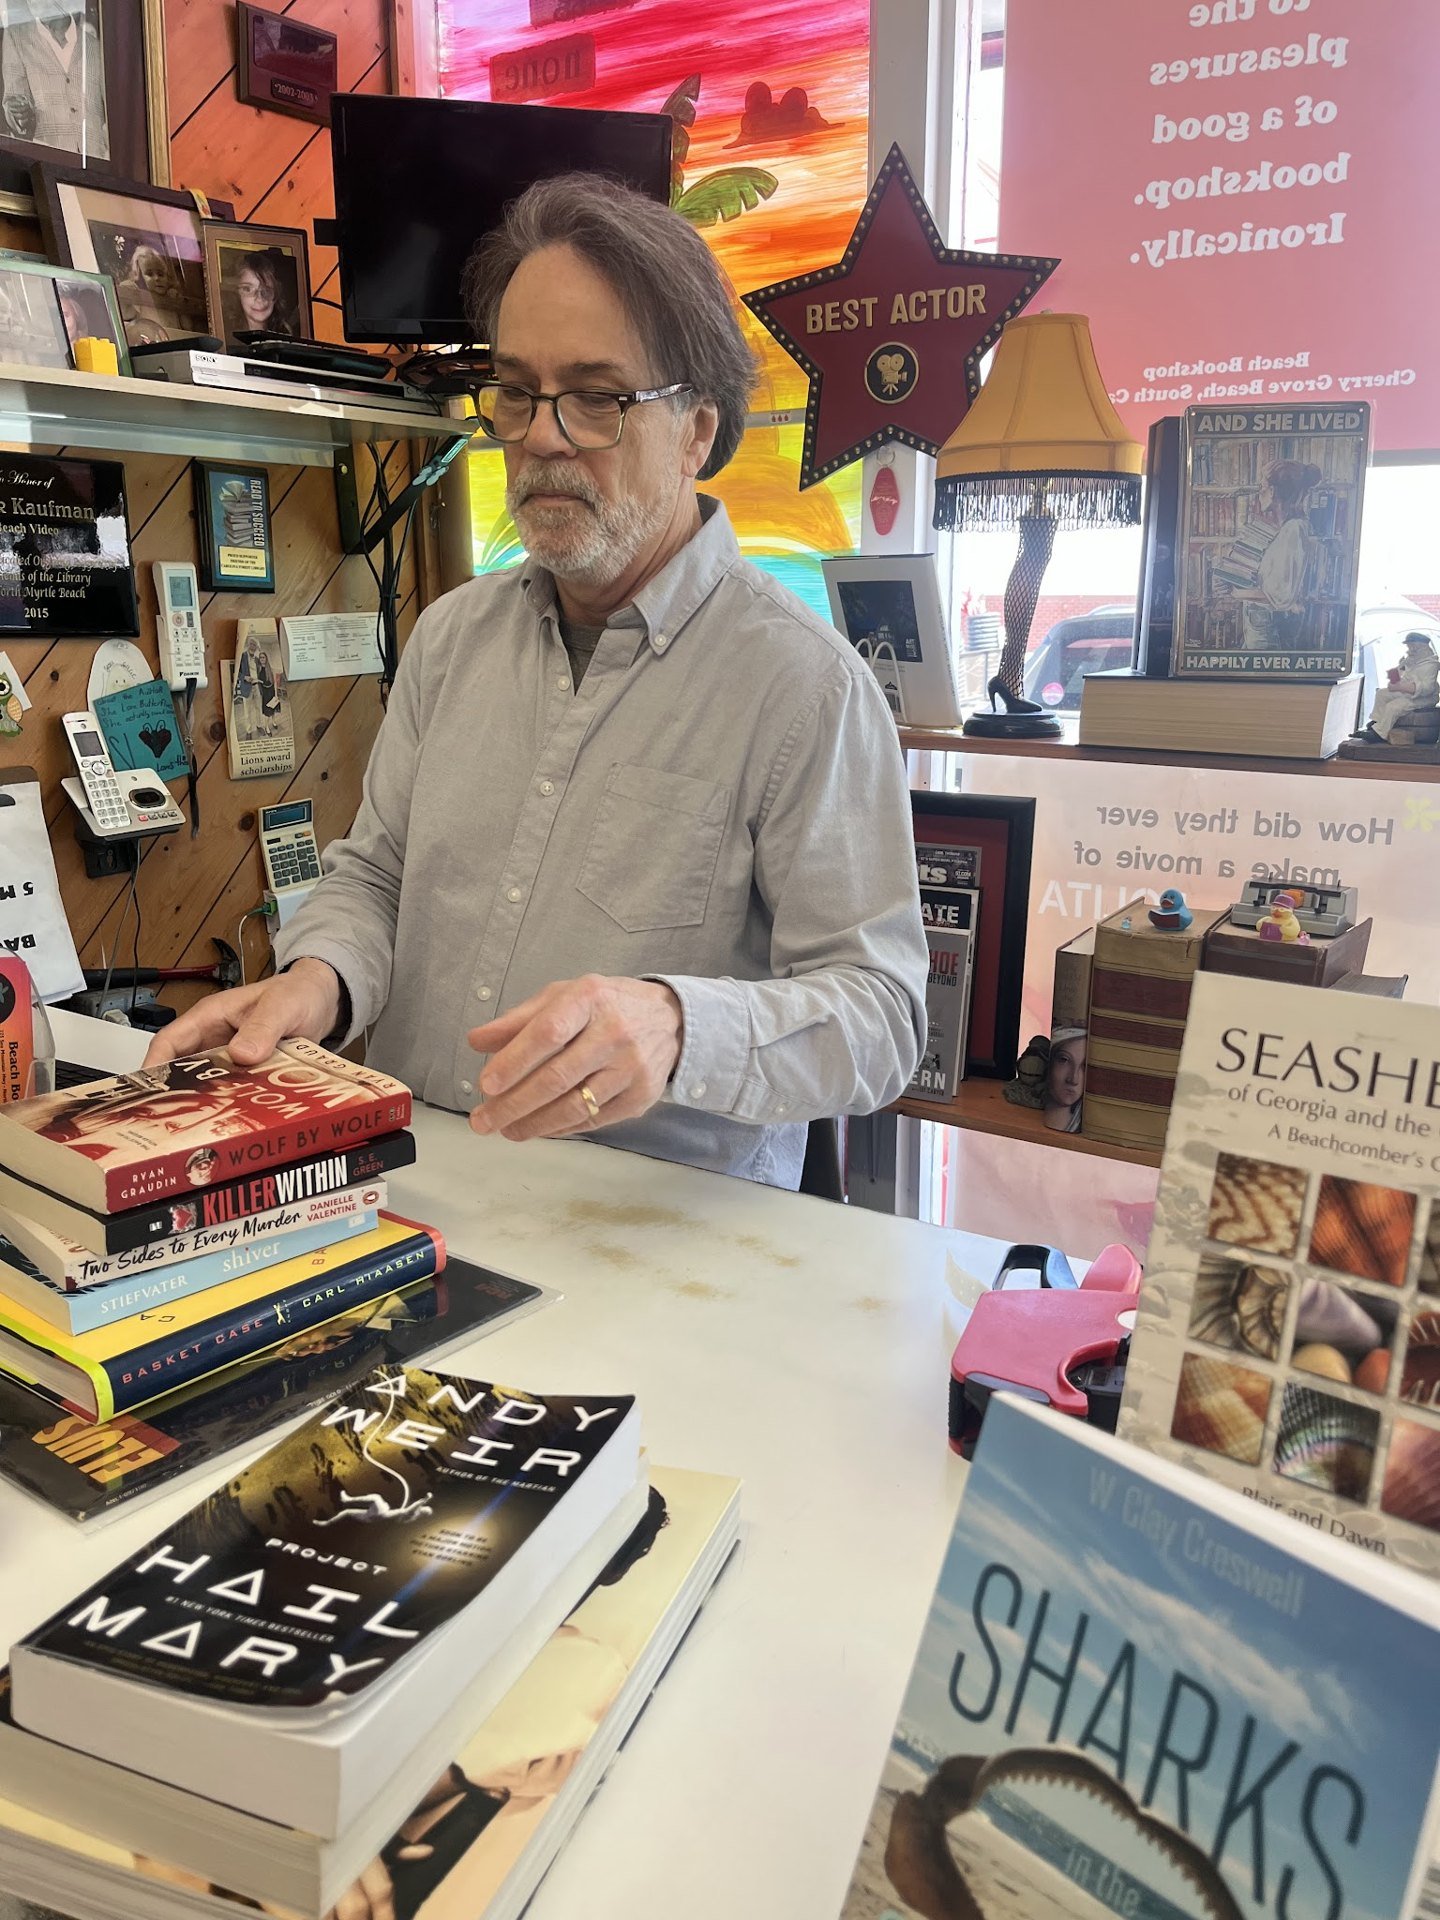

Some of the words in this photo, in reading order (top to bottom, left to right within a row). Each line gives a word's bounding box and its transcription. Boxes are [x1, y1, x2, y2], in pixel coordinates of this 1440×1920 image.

[806, 297, 878, 335] BEST
[890, 284, 986, 326] ACTOR
[195, 354, 218, 363] SONY
[1198, 413, 1247, 432] AND
[1252, 412, 1295, 431] SHE
[1299, 412, 1361, 431] LIVED
[11, 497, 95, 520] Kaufman
[29, 524, 59, 536] Video
[23, 586, 56, 601] Myrtle
[58, 587, 86, 599] Beach
[28, 572, 38, 585] of
[40, 572, 54, 583] the
[56, 572, 91, 586] Library
[24, 607, 49, 618] 2015
[1186, 656, 1249, 669] HAPPILY
[1252, 656, 1291, 670] EVER
[1295, 656, 1342, 671] AFTER
[240, 755, 264, 766] Lions
[266, 752, 291, 763] award
[240, 764, 292, 777] scholarships
[9, 1041, 20, 1079] Beach
[175, 1058, 231, 1081] BY
[287, 1038, 346, 1070] GRAUDI
[352, 1069, 396, 1090] RYAN
[217, 1081, 310, 1120] WOLF
[1227, 1084, 1252, 1102] of
[1256, 1088, 1337, 1122] Georgia
[1345, 1109, 1388, 1129] and
[1395, 1113, 1431, 1137] the
[229, 1139, 286, 1166] WOLF
[297, 1127, 320, 1148] BY
[331, 1111, 382, 1137] WOLF
[1268, 1123, 1282, 1139] A
[1287, 1126, 1424, 1169] Beachcomber's
[132, 1166, 165, 1184] RYAN
[352, 1161, 384, 1177] GREEN
[120, 1176, 177, 1199] GRAUDIN
[309, 1193, 354, 1212] DANIELLE
[307, 1203, 357, 1222] VALENTINE
[79, 1259, 113, 1283] Two
[117, 1245, 166, 1272] Sides
[169, 1238, 188, 1254] to
[193, 1227, 239, 1252] Every
[243, 1210, 303, 1237] Murder
[223, 1241, 281, 1273] shiver
[100, 1274, 188, 1315] STIEFVATER
[121, 1344, 202, 1385] BASKET
[215, 1319, 264, 1345] CASE
[302, 1285, 346, 1309] CARL
[365, 1367, 620, 1433] ANDY
[321, 1403, 582, 1478] WEIR
[435, 1466, 474, 1479] AUTHOR
[491, 1477, 510, 1486] THE
[511, 1481, 557, 1492] MARTIAN
[1087, 1466, 1116, 1510] W
[1120, 1484, 1182, 1555] Clay
[1182, 1514, 1304, 1620] Creswell
[1288, 1506, 1323, 1530] and
[1330, 1519, 1386, 1556] Dawn
[266, 1538, 388, 1576] PROJECT
[135, 1544, 421, 1640] HAIL
[180, 1599, 203, 1611] NEW
[206, 1606, 233, 1620] YORK
[235, 1614, 268, 1628] TIMES
[268, 1622, 336, 1643] BESTSELLER
[68, 1596, 385, 1689] MARY
[948, 1562, 1367, 1920] SHARKS
[1066, 1847, 1092, 1886] in
[1096, 1863, 1141, 1917] the
